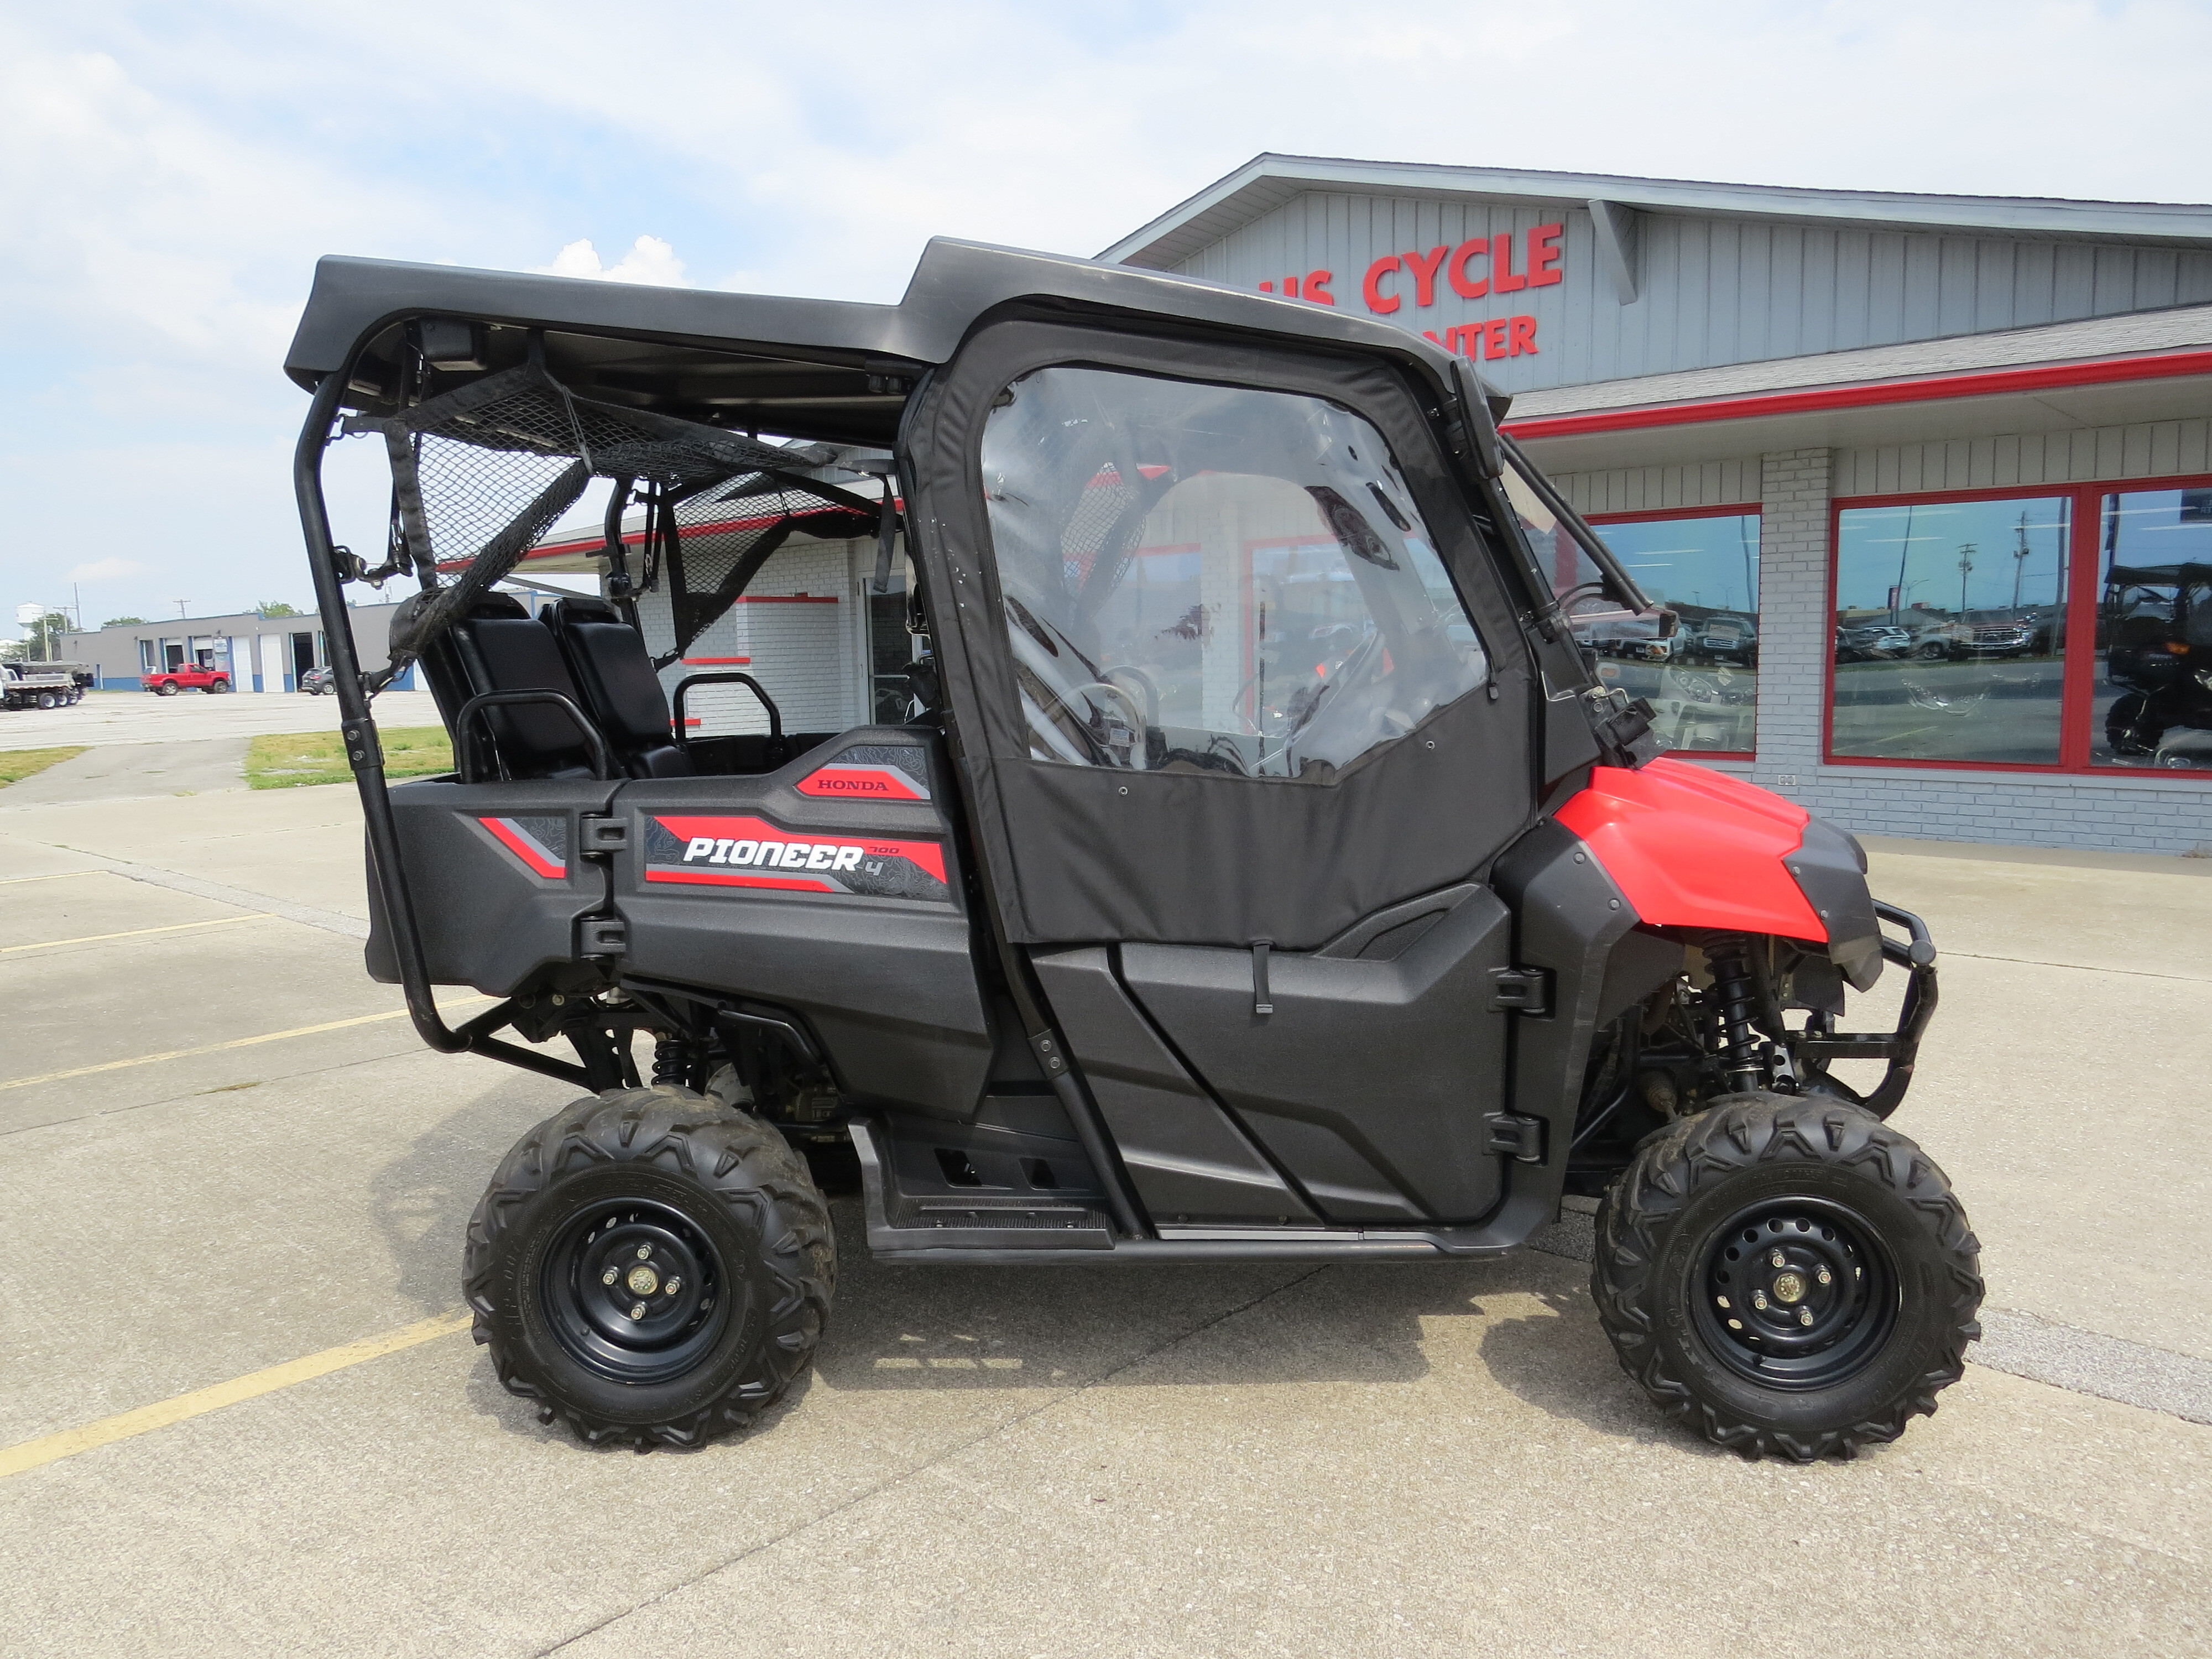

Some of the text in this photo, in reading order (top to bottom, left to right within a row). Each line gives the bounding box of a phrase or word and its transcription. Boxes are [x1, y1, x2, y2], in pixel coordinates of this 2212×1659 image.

[1259, 223, 1562, 314] S CYCLE
[817, 780, 889, 791] HONDA
[683, 837, 864, 872] PIONEER
